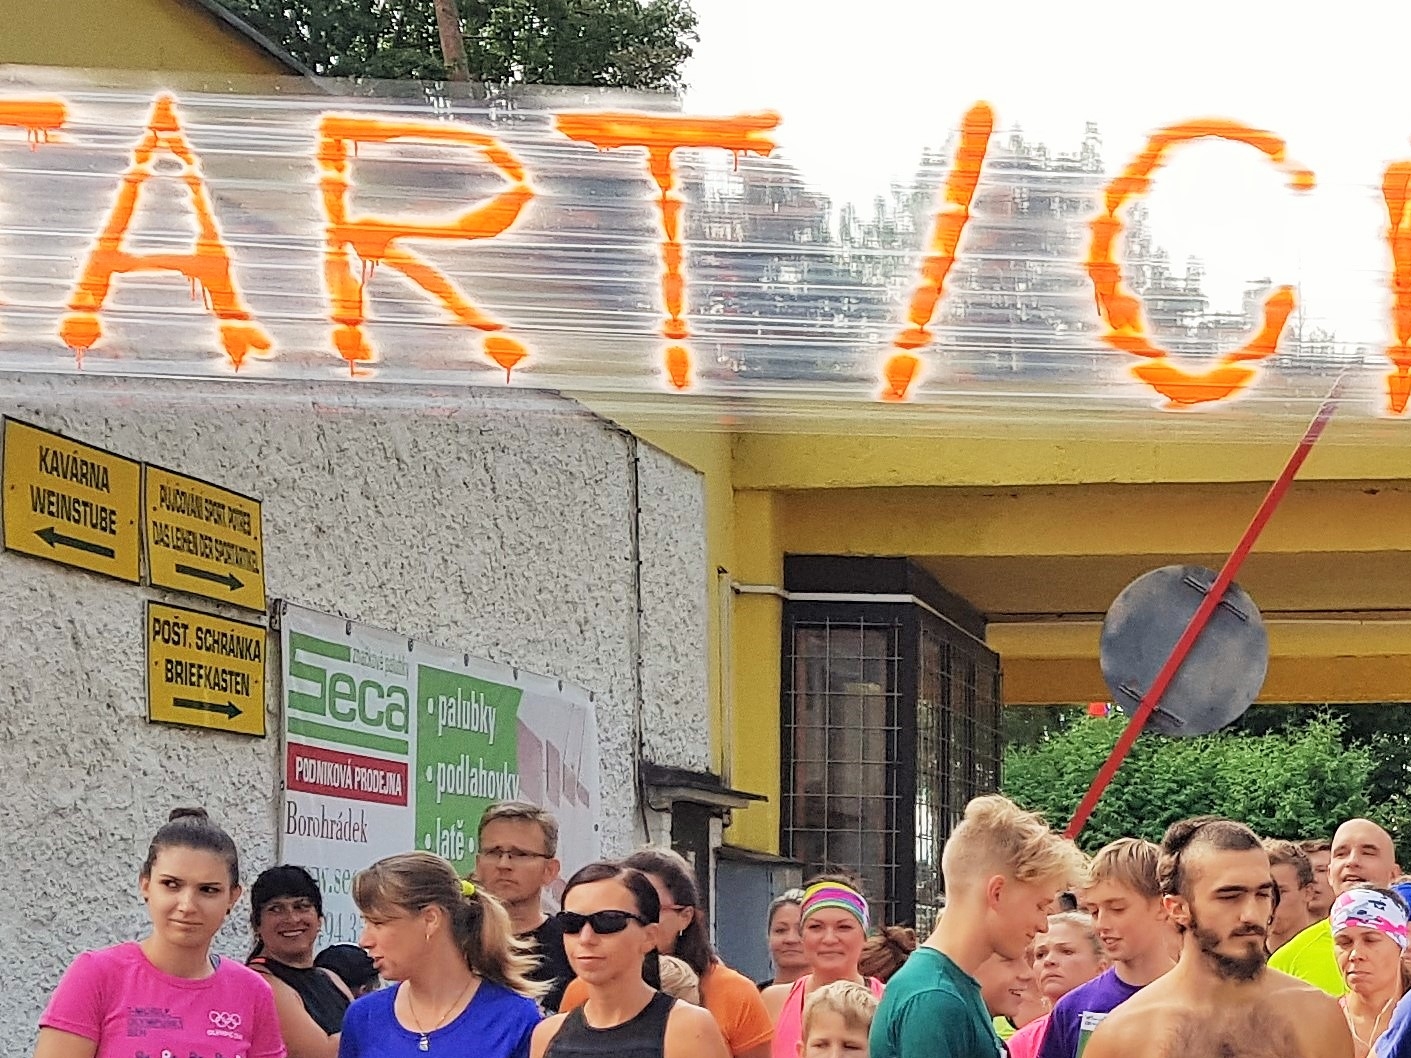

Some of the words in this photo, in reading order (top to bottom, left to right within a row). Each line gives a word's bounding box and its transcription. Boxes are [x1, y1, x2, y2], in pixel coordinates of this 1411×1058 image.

[38, 445, 110, 493] KAVÁRNA
[29, 484, 117, 535] WEINSTUBE
[152, 615, 192, 649] POŠT.
[195, 627, 262, 663] SCHRÁNKA
[164, 658, 250, 697] BRIEFKASTEN
[438, 687, 497, 745] palubky
[295, 756, 352, 789] PODNIKOVÁ
[354, 765, 403, 797] PRODEJNA
[436, 753, 520, 804] podlahovky
[285, 800, 368, 843] Borohrádek
[436, 817, 465, 861] latě
